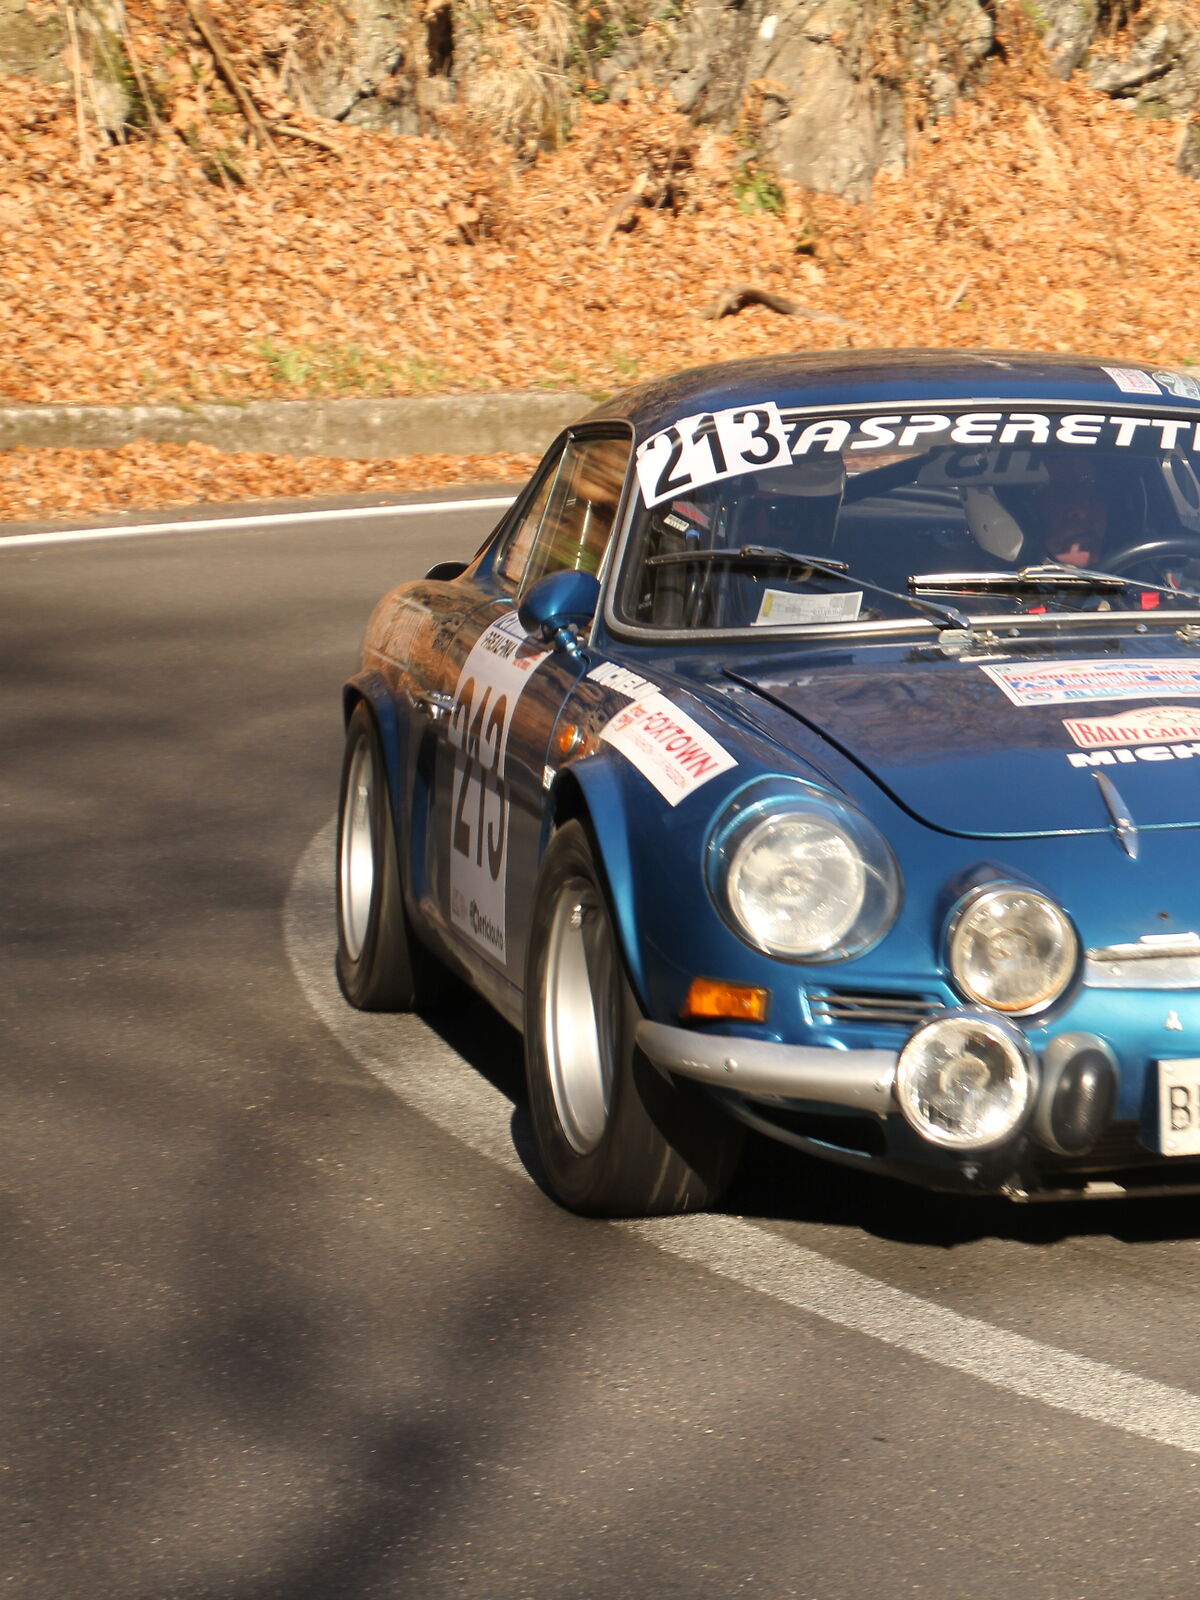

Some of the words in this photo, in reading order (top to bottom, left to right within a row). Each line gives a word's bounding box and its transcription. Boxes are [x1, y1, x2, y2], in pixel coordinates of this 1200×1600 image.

[646, 409, 781, 498] 213
[637, 711, 720, 779] FOXTOWN
[1075, 721, 1140, 744] RALLY
[1142, 726, 1188, 739] CAR
[451, 676, 508, 882] 213
